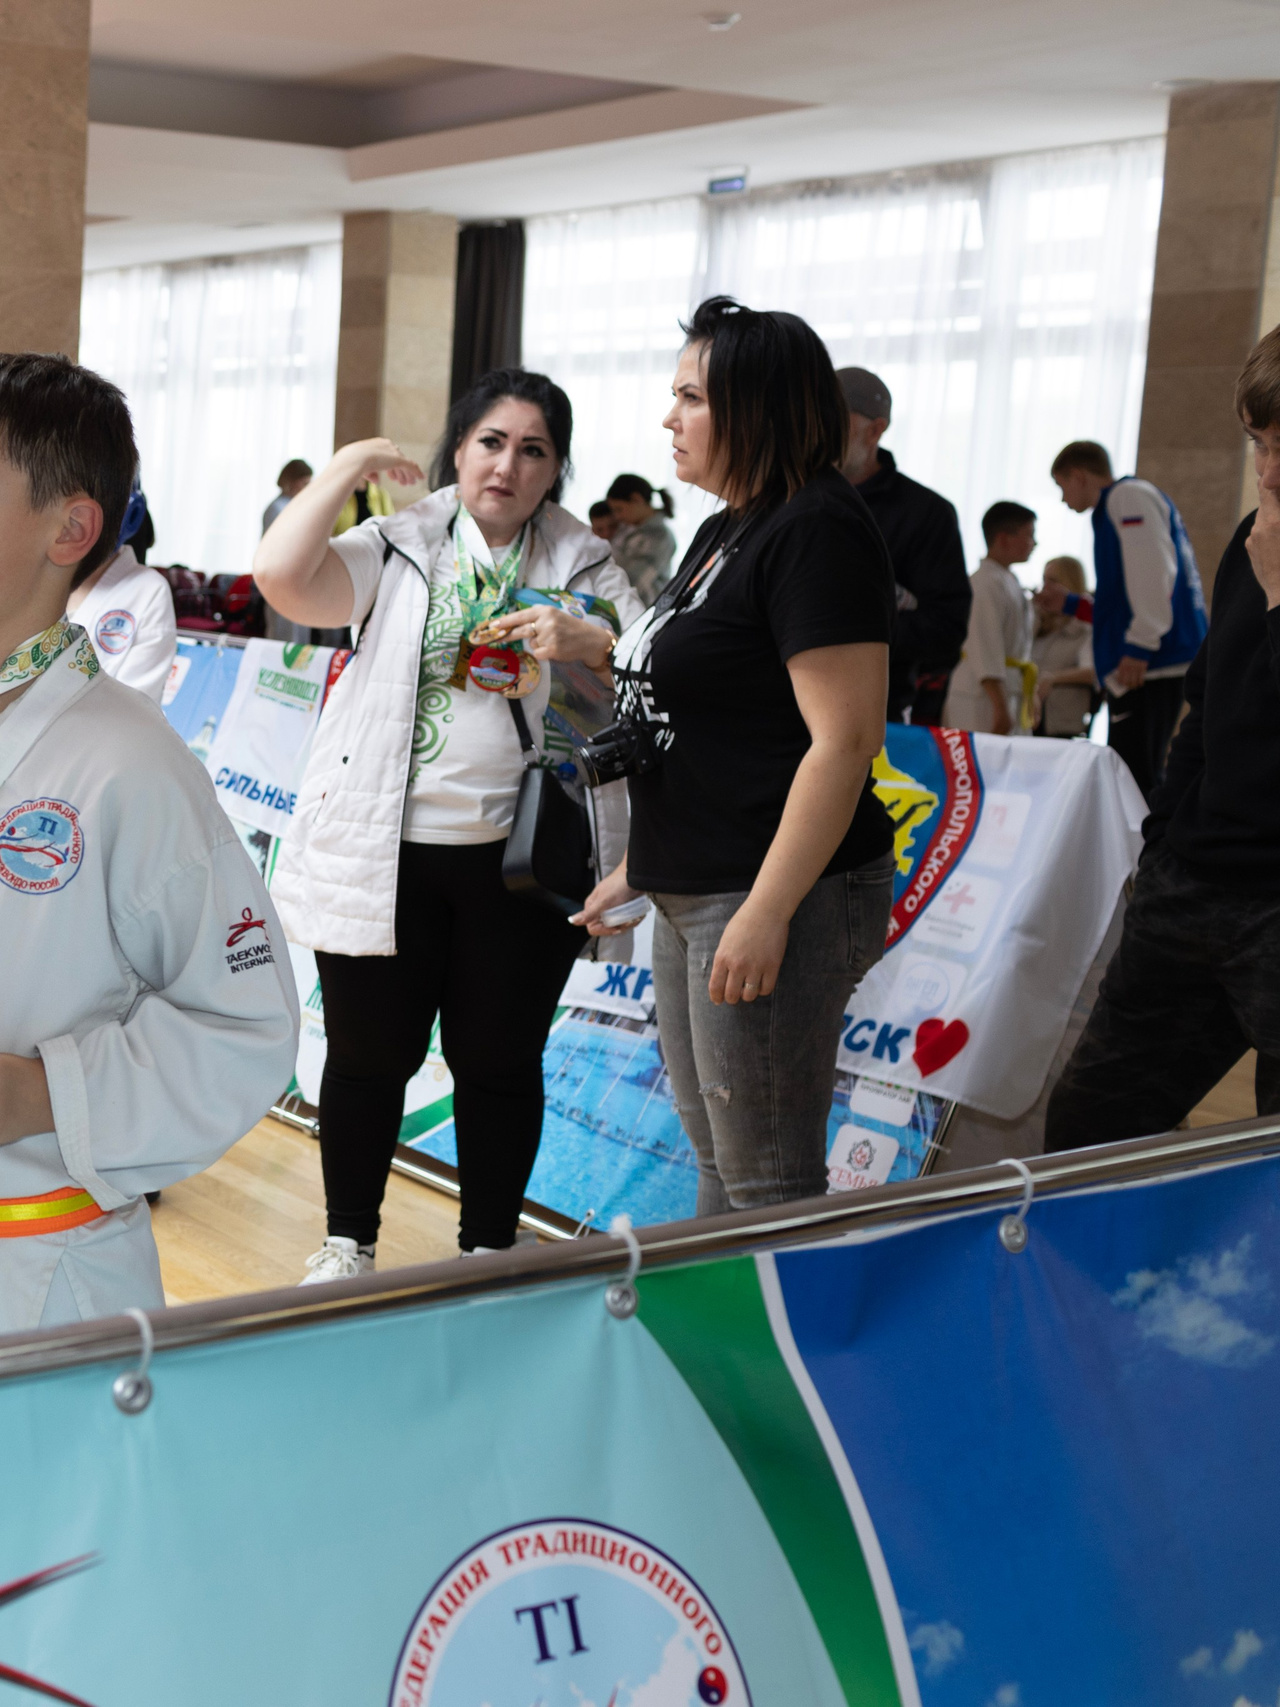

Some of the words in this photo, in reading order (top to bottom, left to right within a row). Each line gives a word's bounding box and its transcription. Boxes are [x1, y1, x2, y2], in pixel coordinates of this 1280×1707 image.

[214, 766, 298, 815] СИЛЬНЫЕ
[38, 815, 59, 836] TI
[903, 727, 975, 914] ТАВРОПОЛЬСКОГО
[225, 943, 273, 965] TAEKWO
[230, 954, 275, 974] INTERNAT
[399, 1558, 491, 1707] ЕДЕРАЦИЯ
[496, 1529, 723, 1657] ТРАДИЦИОННОГО
[514, 1593, 590, 1666] TI
